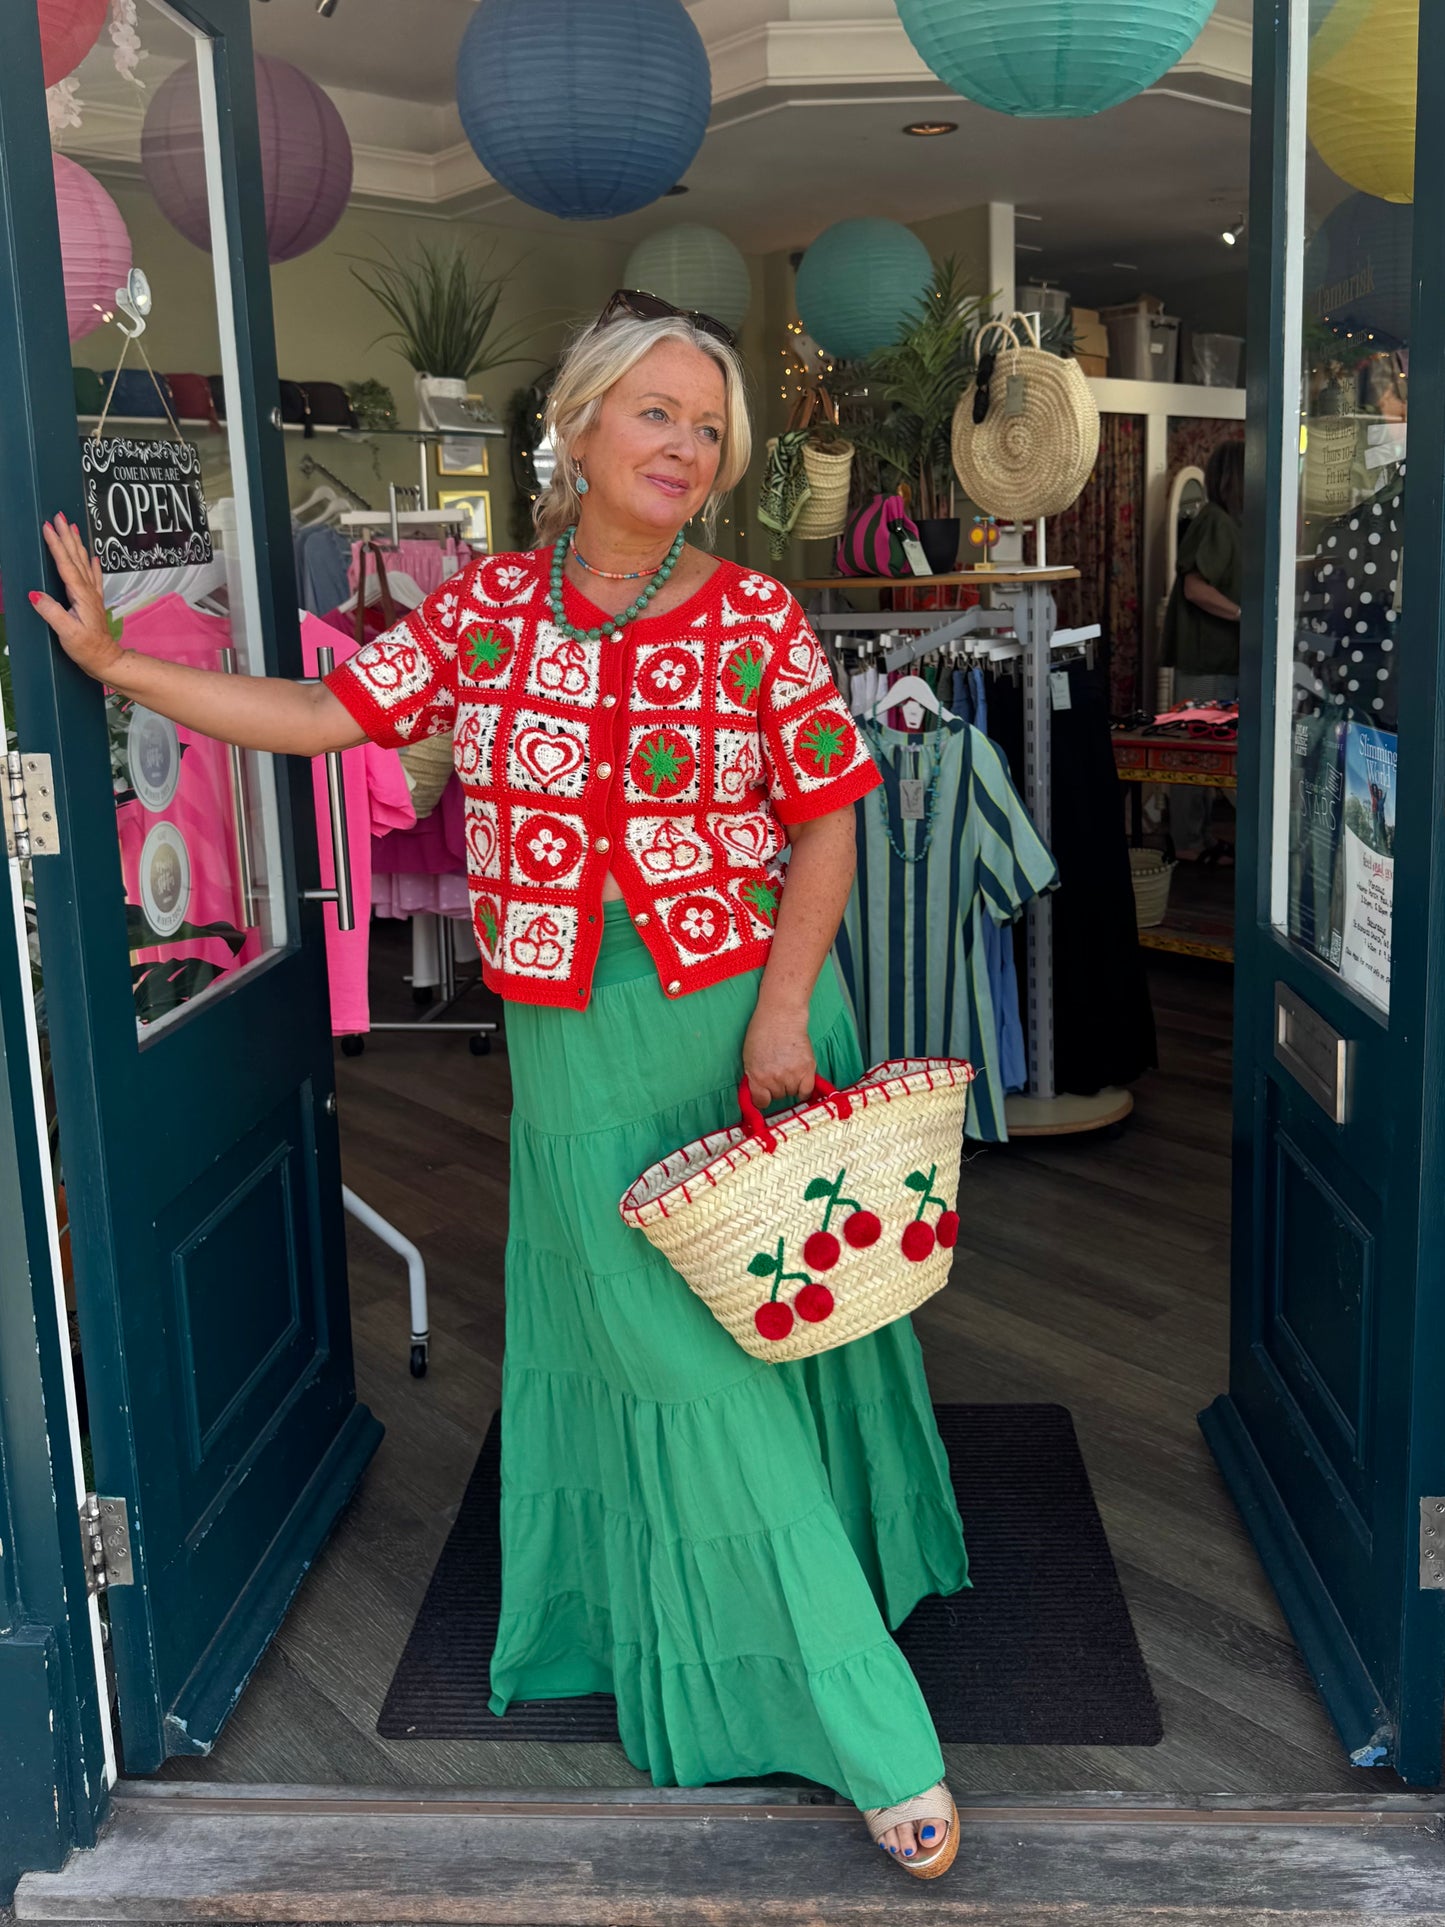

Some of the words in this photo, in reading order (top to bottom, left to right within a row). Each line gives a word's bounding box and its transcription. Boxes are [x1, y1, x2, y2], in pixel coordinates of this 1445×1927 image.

[113, 466, 140, 481] COME
[140, 467, 149, 481] IN
[150, 467, 164, 481] WE
[165, 467, 181, 481] ARE
[107, 482, 195, 537] OPEN
[1359, 733, 1398, 773] Slimming
[1366, 758, 1391, 789] World
[1298, 779, 1337, 831] STARS
